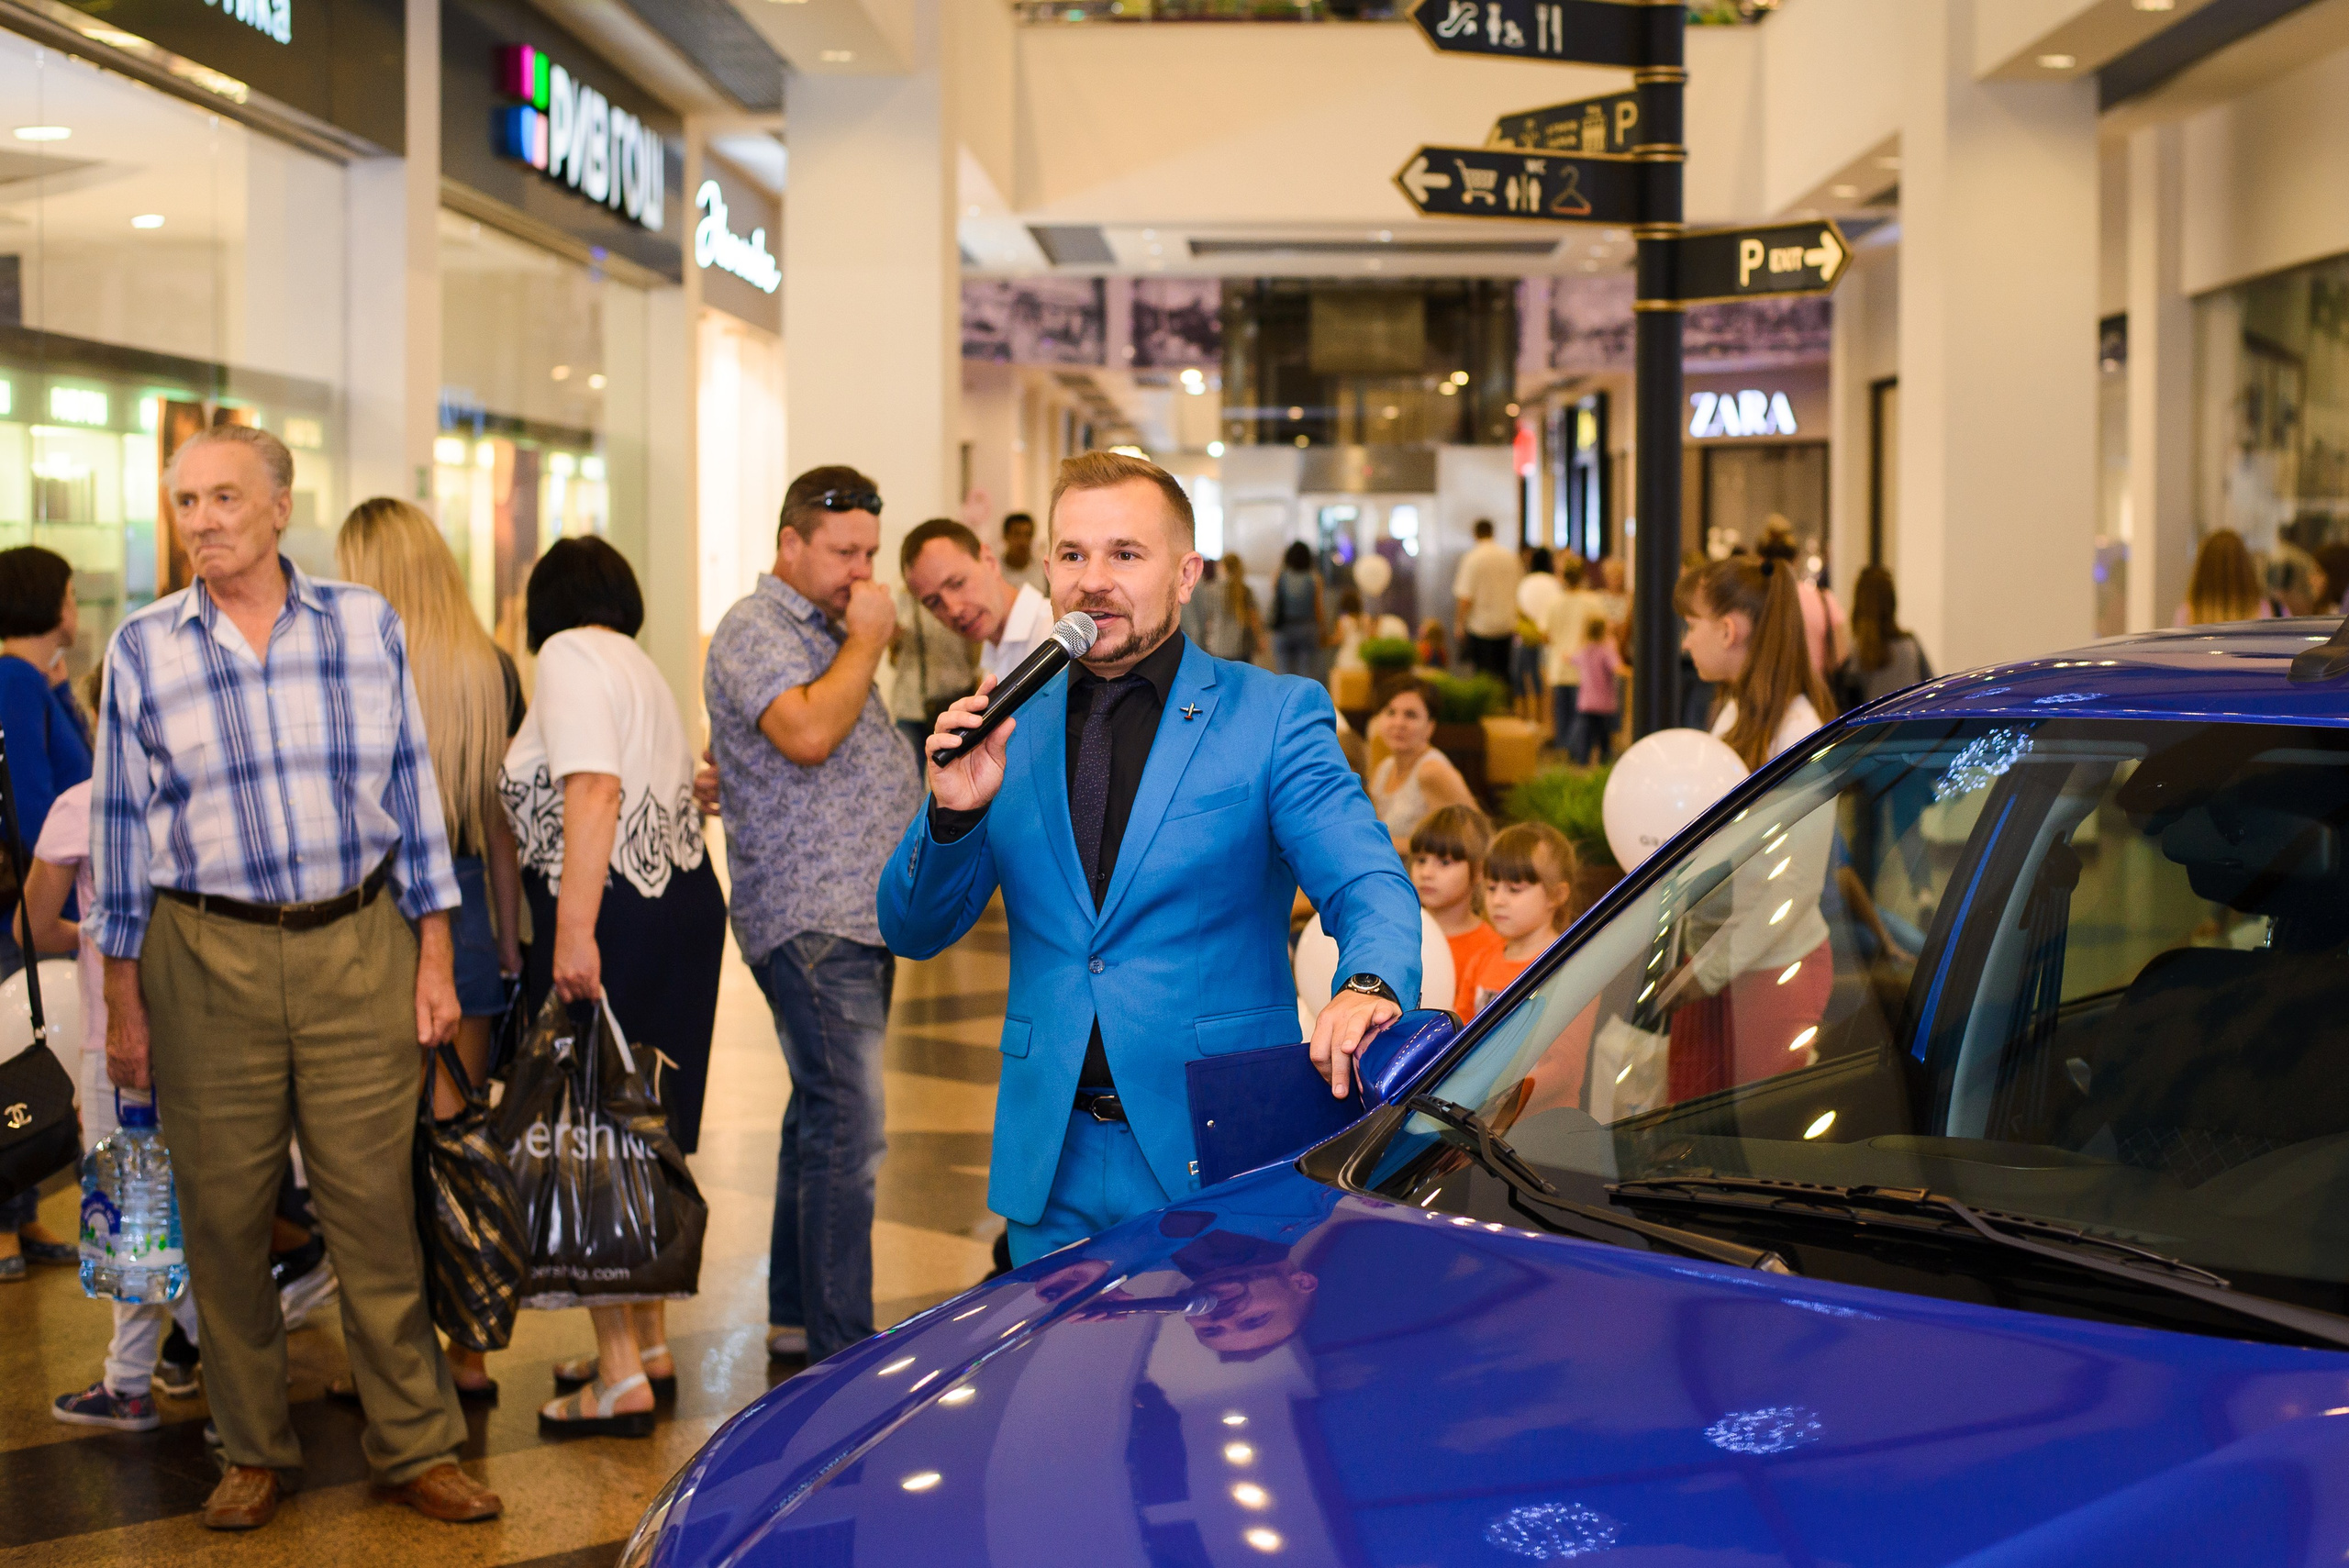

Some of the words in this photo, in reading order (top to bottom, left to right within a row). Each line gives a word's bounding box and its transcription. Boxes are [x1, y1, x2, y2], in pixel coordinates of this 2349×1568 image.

[1614, 100, 1639, 147] P
[1740, 239, 1765, 287] P
[1768, 246, 1804, 273] EXIT
[1689, 390, 1797, 438] ZARA
